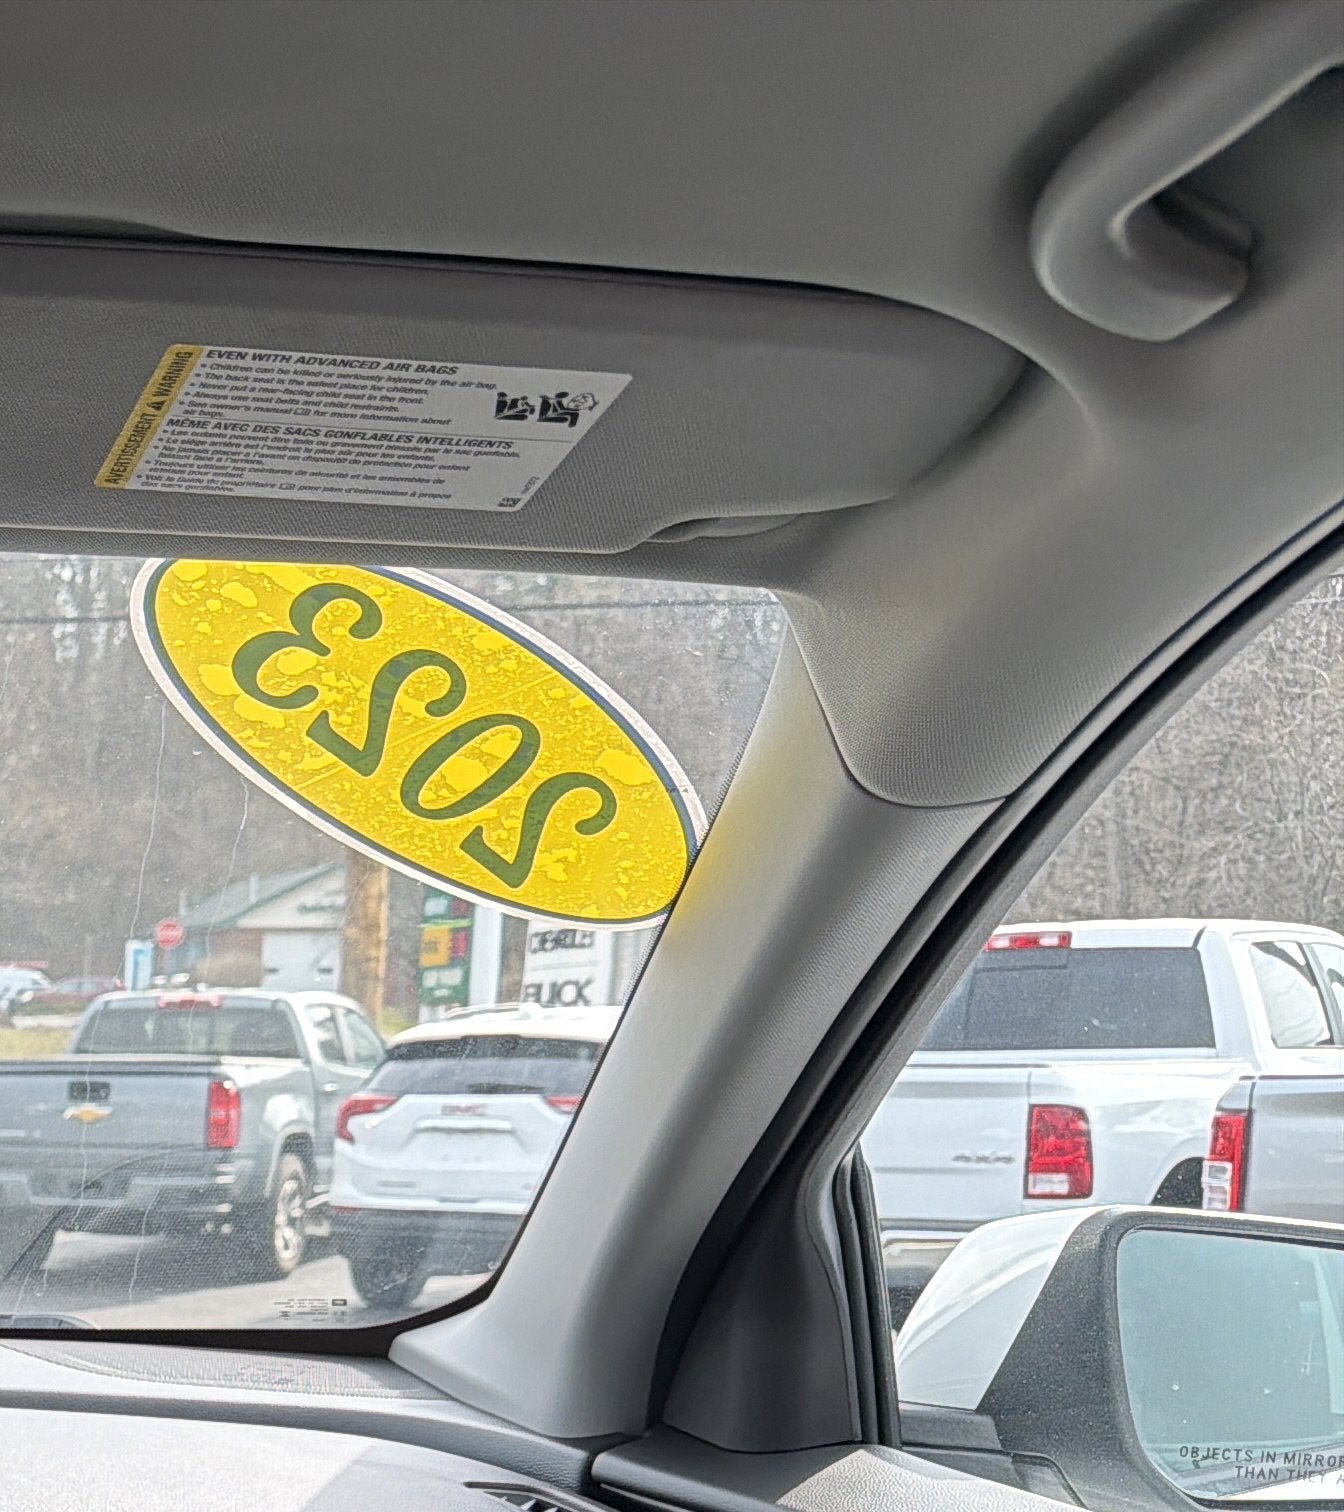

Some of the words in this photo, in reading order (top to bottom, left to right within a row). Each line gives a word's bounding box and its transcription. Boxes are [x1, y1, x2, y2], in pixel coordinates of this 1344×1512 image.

[152, 351, 193, 397] WARNING
[206, 349, 248, 360] EVEN
[250, 352, 292, 364] WITH
[293, 355, 381, 370] ADVANCED
[383, 361, 413, 373] AIR
[414, 364, 460, 375] BAGS
[166, 416, 210, 429] MÊME
[212, 421, 250, 432] AVEC
[252, 424, 282, 434] DES
[282, 426, 321, 437] SACS
[324, 428, 417, 444] GONFLABLES
[417, 435, 514, 450] INTELLIGENTS
[104, 412, 158, 485] AVERTISSEMENT
[1179, 1445, 1253, 1462] OBJECTS
[1262, 1451, 1277, 1463] IN
[1235, 1465, 1279, 1480] THAN
[1287, 1468, 1326, 1484] THEY
